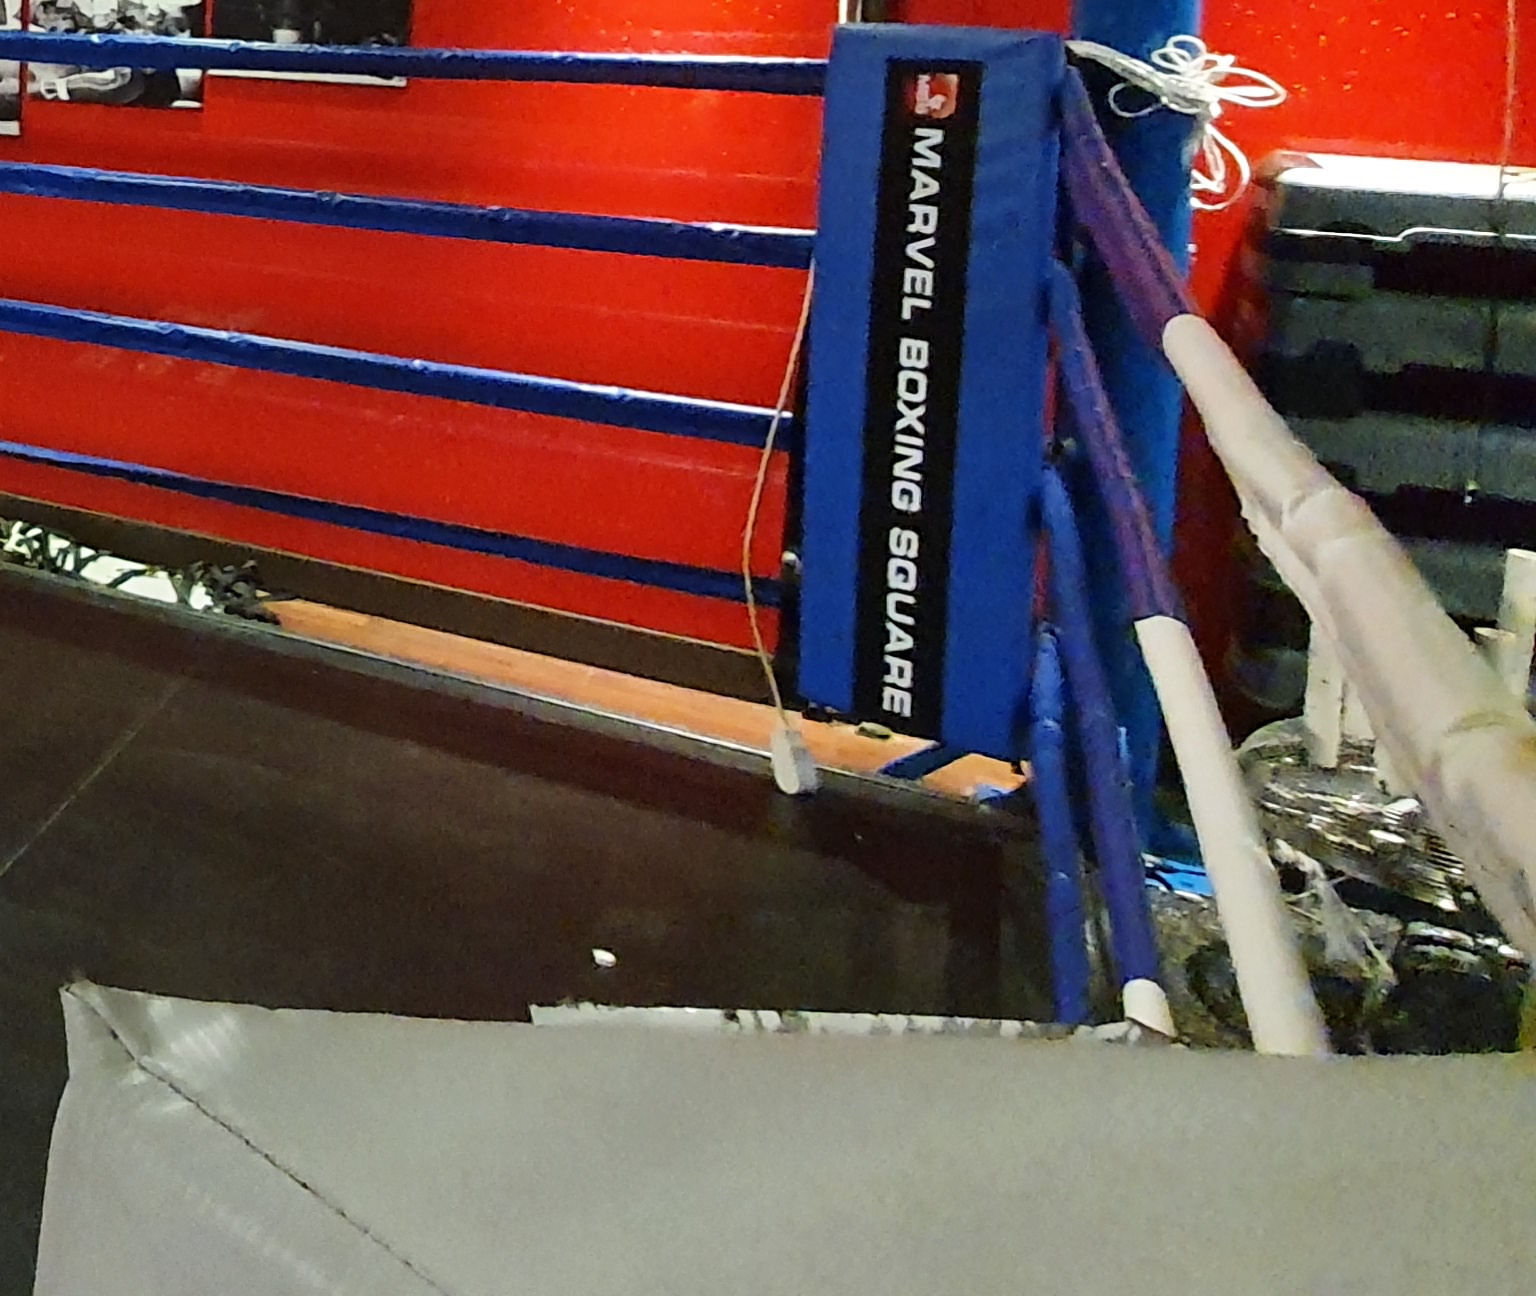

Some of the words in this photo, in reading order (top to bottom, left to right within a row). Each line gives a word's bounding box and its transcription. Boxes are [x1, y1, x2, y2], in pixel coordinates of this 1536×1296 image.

[901, 126, 945, 321] MARVEL
[891, 336, 930, 514] BOXING
[881, 525, 920, 719] SQUARE
